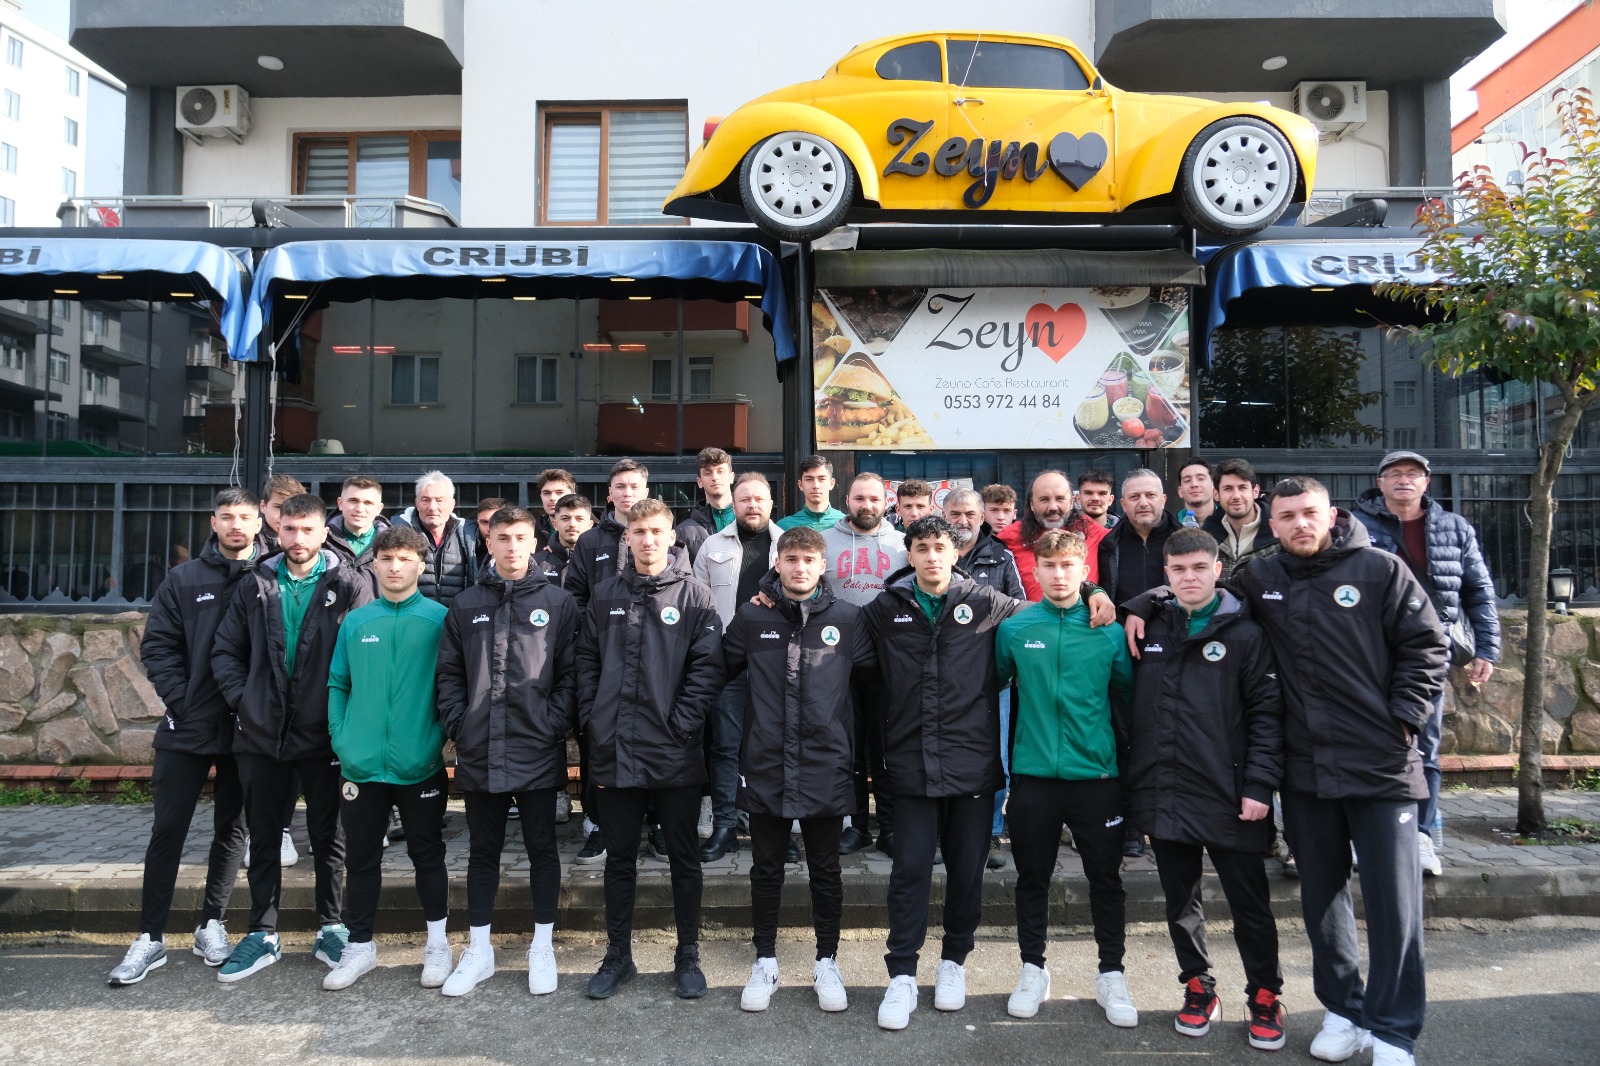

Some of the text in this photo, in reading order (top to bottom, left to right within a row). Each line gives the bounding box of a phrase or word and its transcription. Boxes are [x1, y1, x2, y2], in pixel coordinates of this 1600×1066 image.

[883, 118, 1050, 209] Zeyn
[925, 292, 1064, 373] Zeyn
[935, 377, 1070, 391] Zeyno Cafe Restaurant
[943, 393, 1061, 409] 0553 972 44 84
[836, 547, 891, 579] GAP
